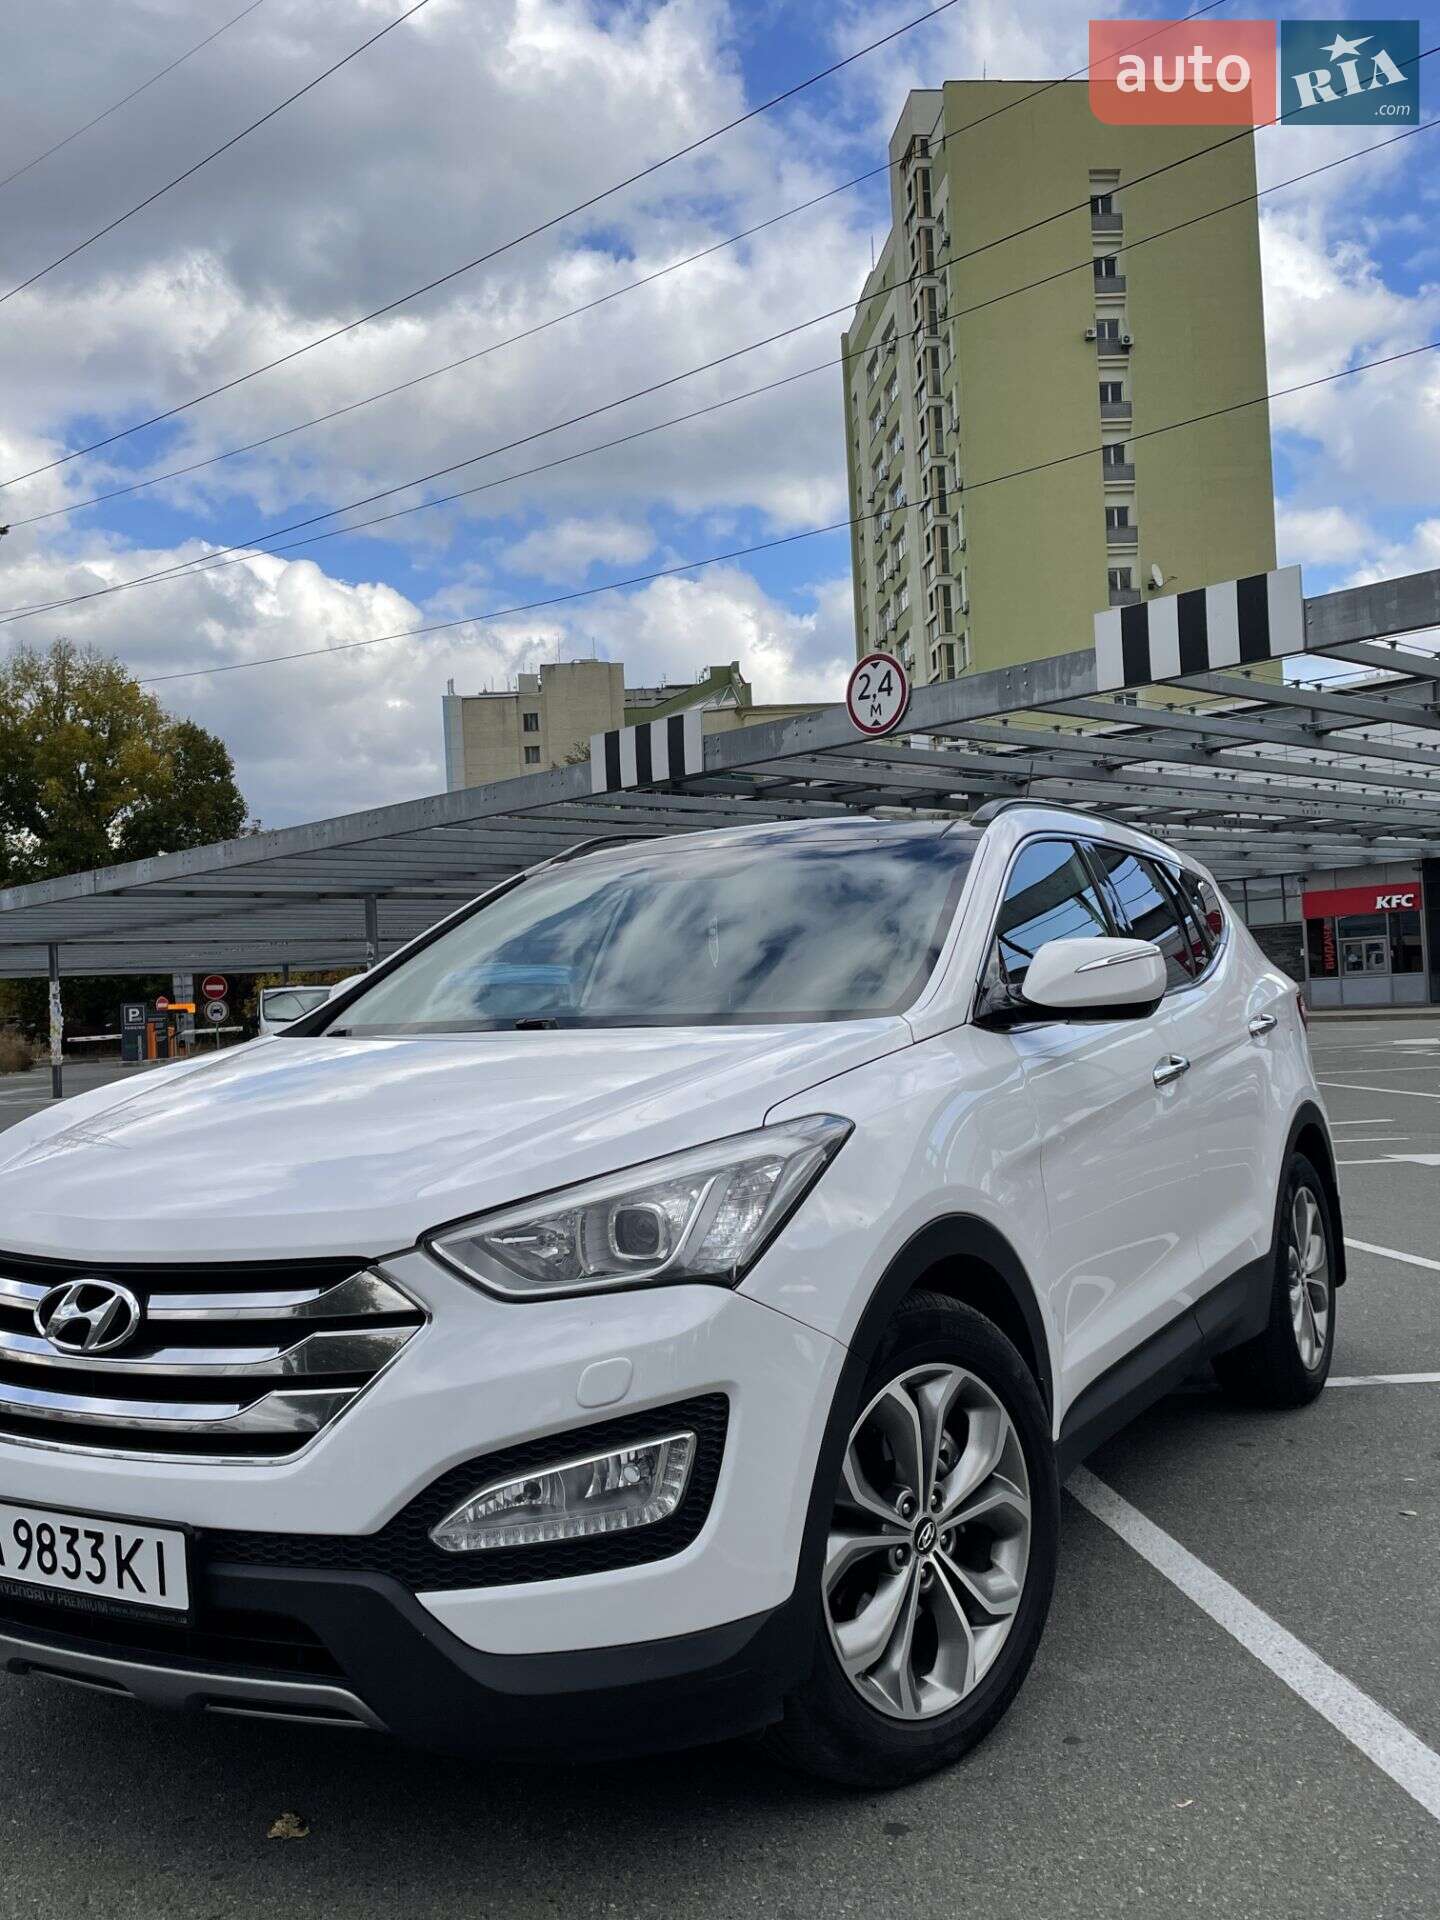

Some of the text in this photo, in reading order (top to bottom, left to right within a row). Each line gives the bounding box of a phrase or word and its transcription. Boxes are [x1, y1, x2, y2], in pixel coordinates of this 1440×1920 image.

[857, 669, 893, 702] 2,4
[1375, 893, 1414, 909] KFC
[128, 1008, 140, 1022] P
